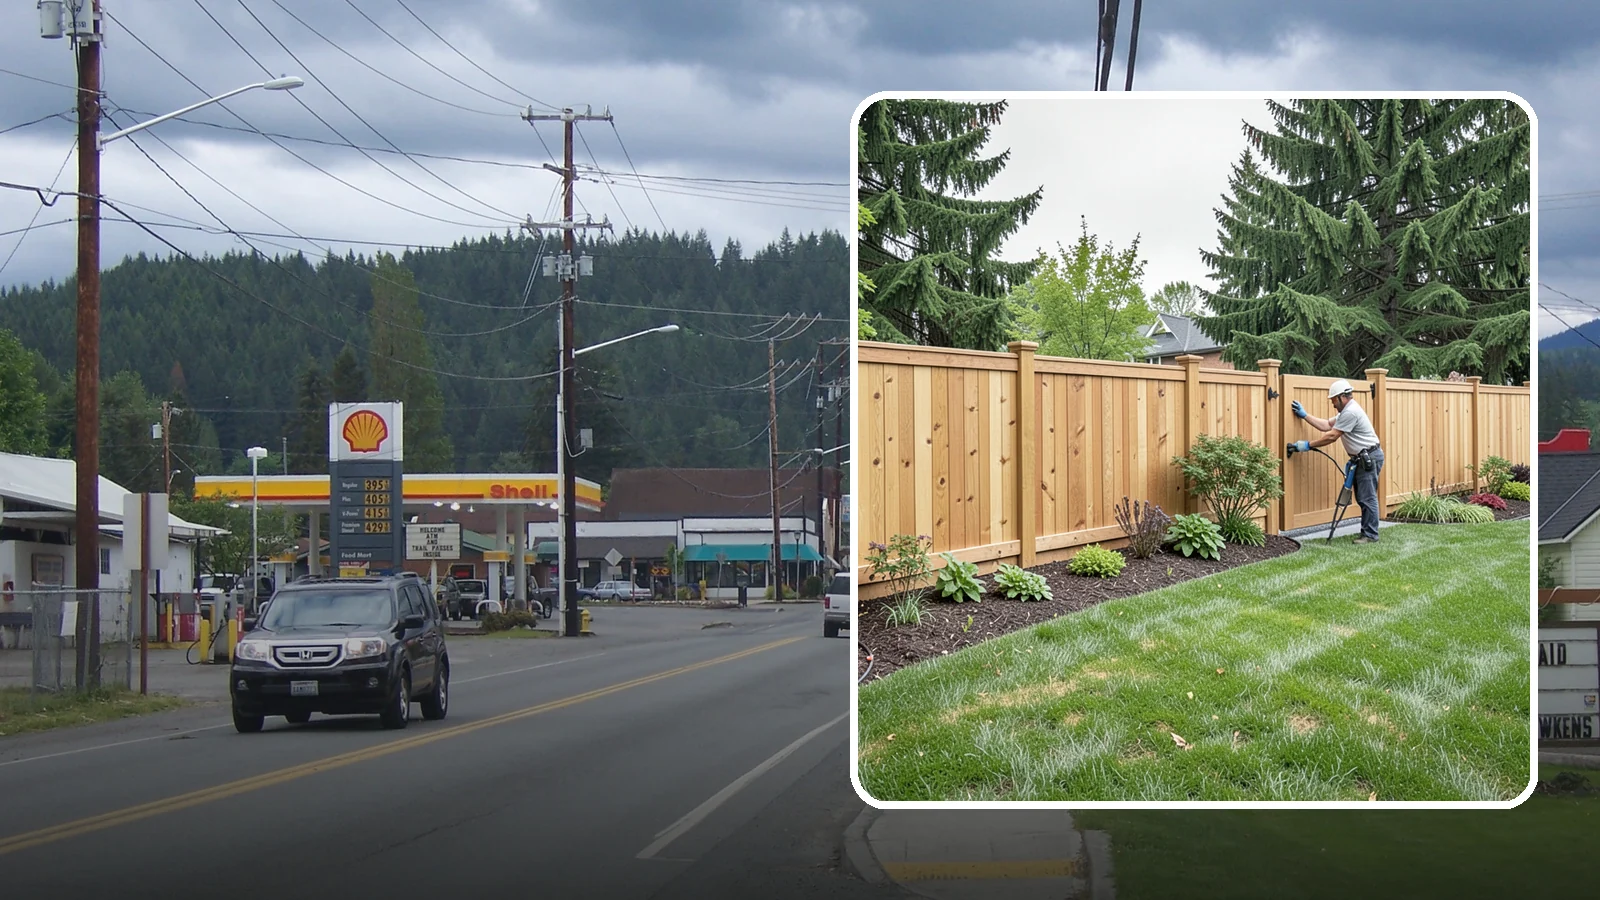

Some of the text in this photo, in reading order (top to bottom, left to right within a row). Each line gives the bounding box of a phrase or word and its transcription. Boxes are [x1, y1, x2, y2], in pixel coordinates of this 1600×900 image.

[366, 480, 384, 490] 395
[366, 494, 384, 504] 405
[366, 508, 384, 518] 415
[366, 522, 384, 532] 429
[1539, 643, 1567, 666] AID
